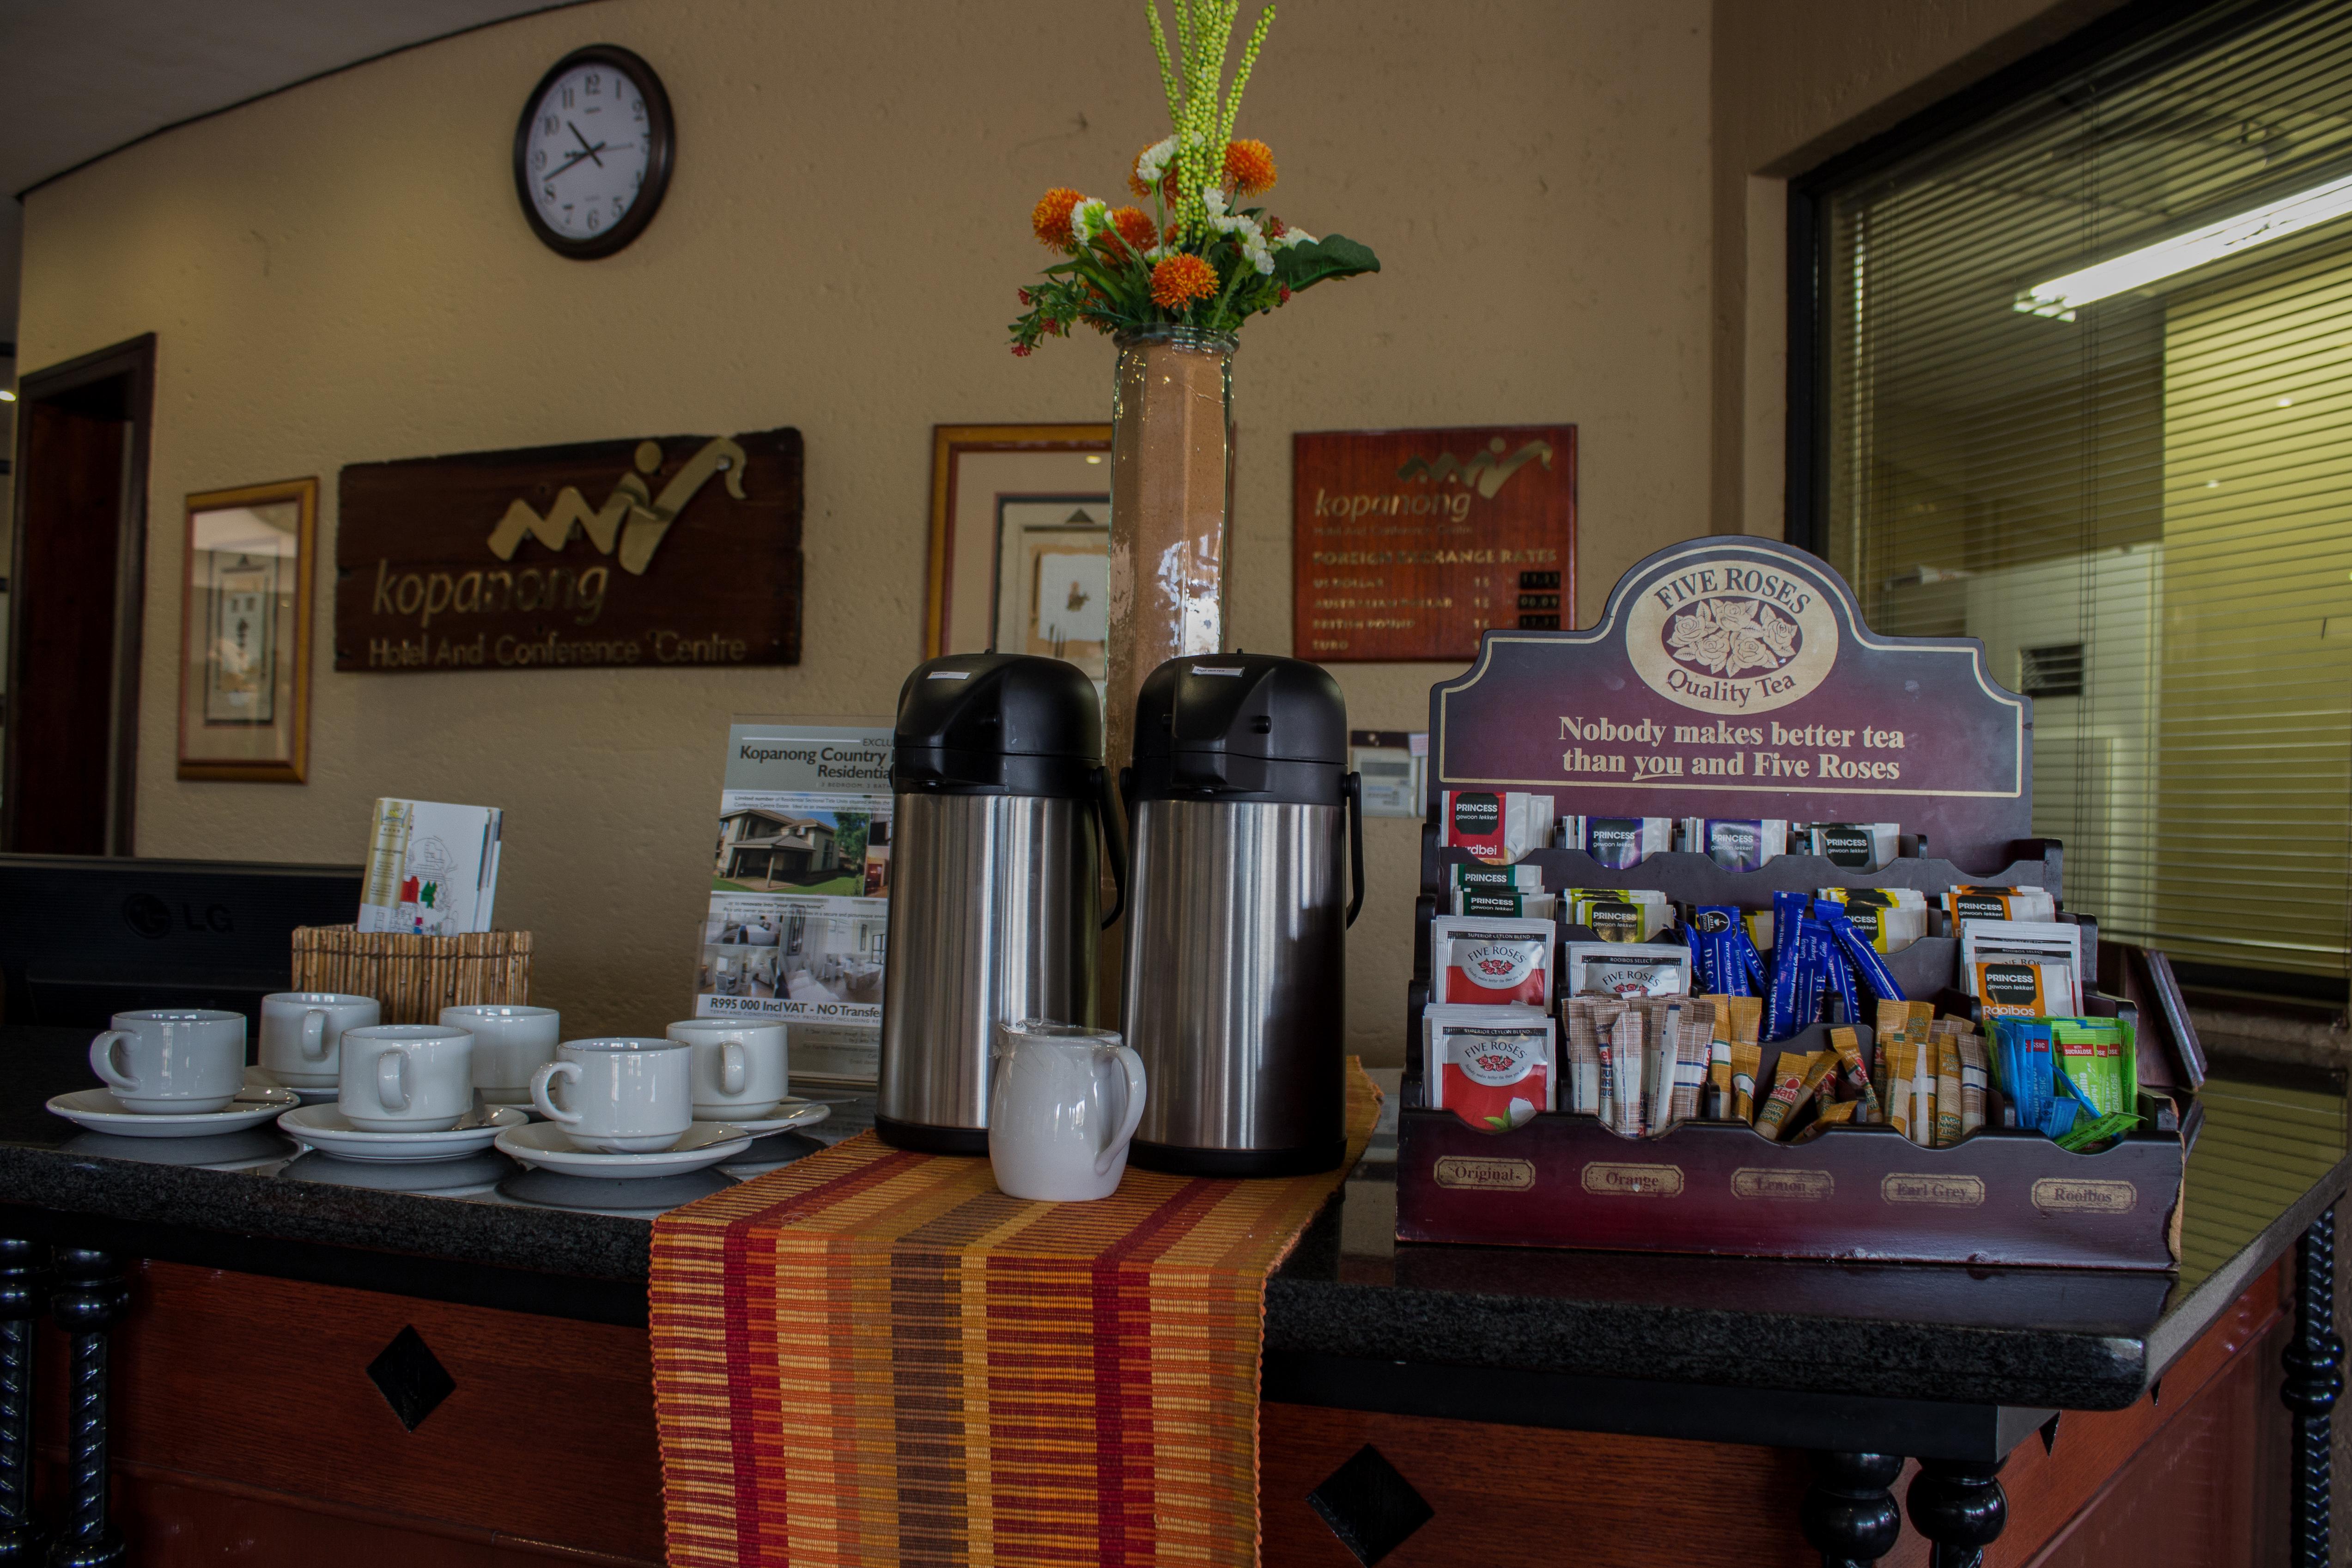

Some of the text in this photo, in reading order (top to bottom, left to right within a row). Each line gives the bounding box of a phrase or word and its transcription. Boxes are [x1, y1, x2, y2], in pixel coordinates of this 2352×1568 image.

[584, 73, 600, 95] 12
[1315, 487, 1472, 523] kopanong
[1500, 549, 1557, 563] RATES
[371, 558, 611, 627] kopanong
[1654, 568, 1811, 614] FIVE ROSES
[370, 629, 746, 668] Hotel And Conference Centre
[1666, 669, 1796, 708] Quality Tea
[1558, 716, 1906, 749] Nobody makes better tea
[863, 739, 892, 747] EXCLU
[740, 745, 887, 766] Kopanong Country
[818, 764, 889, 779] Residentia
[1562, 748, 1900, 781] than you and Five Roses
[1456, 804, 1498, 813] PRINCESS
[1593, 831, 1635, 840] PRINCESS
[1711, 834, 1753, 844] PRINCESS
[1826, 838, 1868, 847] PRINCESS
[1464, 873, 1507, 883] PRINCESS
[1471, 897, 1514, 906] PRINCESS
[1957, 901, 2003, 911] PRINCESS
[182, 901, 234, 933] LG
[1592, 912, 1638, 922] PRINCESS
[1467, 946, 1525, 963] FIVE ROSES
[1704, 948, 1714, 991] DECA
[1602, 970, 1660, 987] FIVE ROSES
[1986, 973, 2034, 984] PRINCESS
[710, 997, 737, 1009] R995
[740, 999, 761, 1010] 000
[784, 1002, 808, 1014] VAT
[817, 1004, 838, 1015] NO
[1814, 975, 1826, 1022] CAFÉ
[1982, 1005, 2036, 1016] Rooibos
[1465, 1041, 1526, 1059] FIVE ROSES
[2109, 1072, 2121, 1112] CRALOSE
[1454, 1165, 1515, 1182] Original
[1605, 1171, 1659, 1189] Orange
[1756, 1179, 1806, 1192] Lemon
[1897, 1182, 1968, 1200] Earl Grey
[2054, 1187, 2112, 1204] Rooibos
